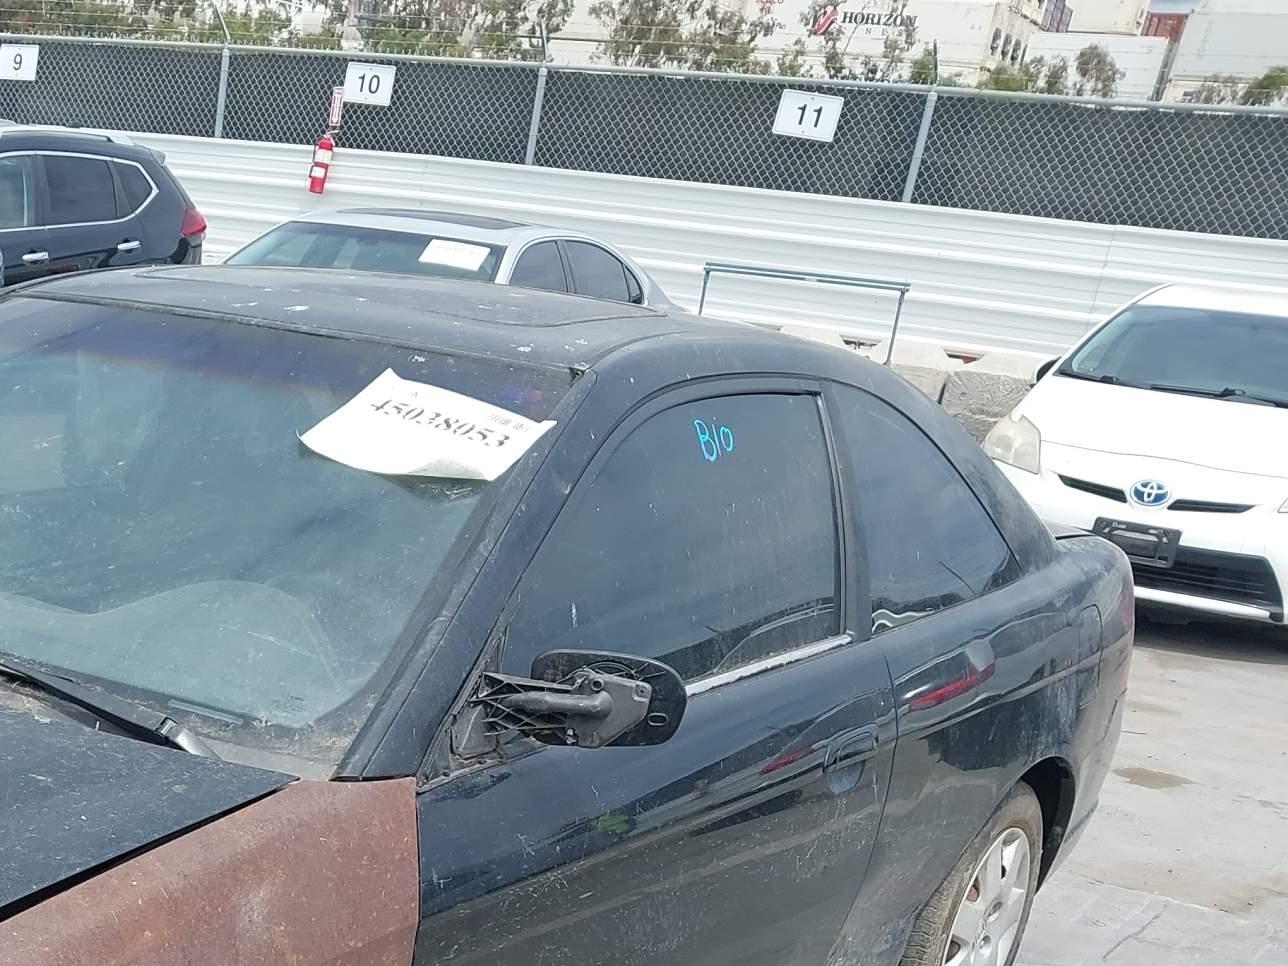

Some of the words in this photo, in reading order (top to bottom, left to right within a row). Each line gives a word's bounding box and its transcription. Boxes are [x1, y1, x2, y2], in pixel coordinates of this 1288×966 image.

[842, 11, 919, 27] HORIZON
[13, 53, 23, 71] 9
[358, 73, 381, 95] 10
[797, 103, 824, 128] 11
[369, 398, 512, 449] 45038053
